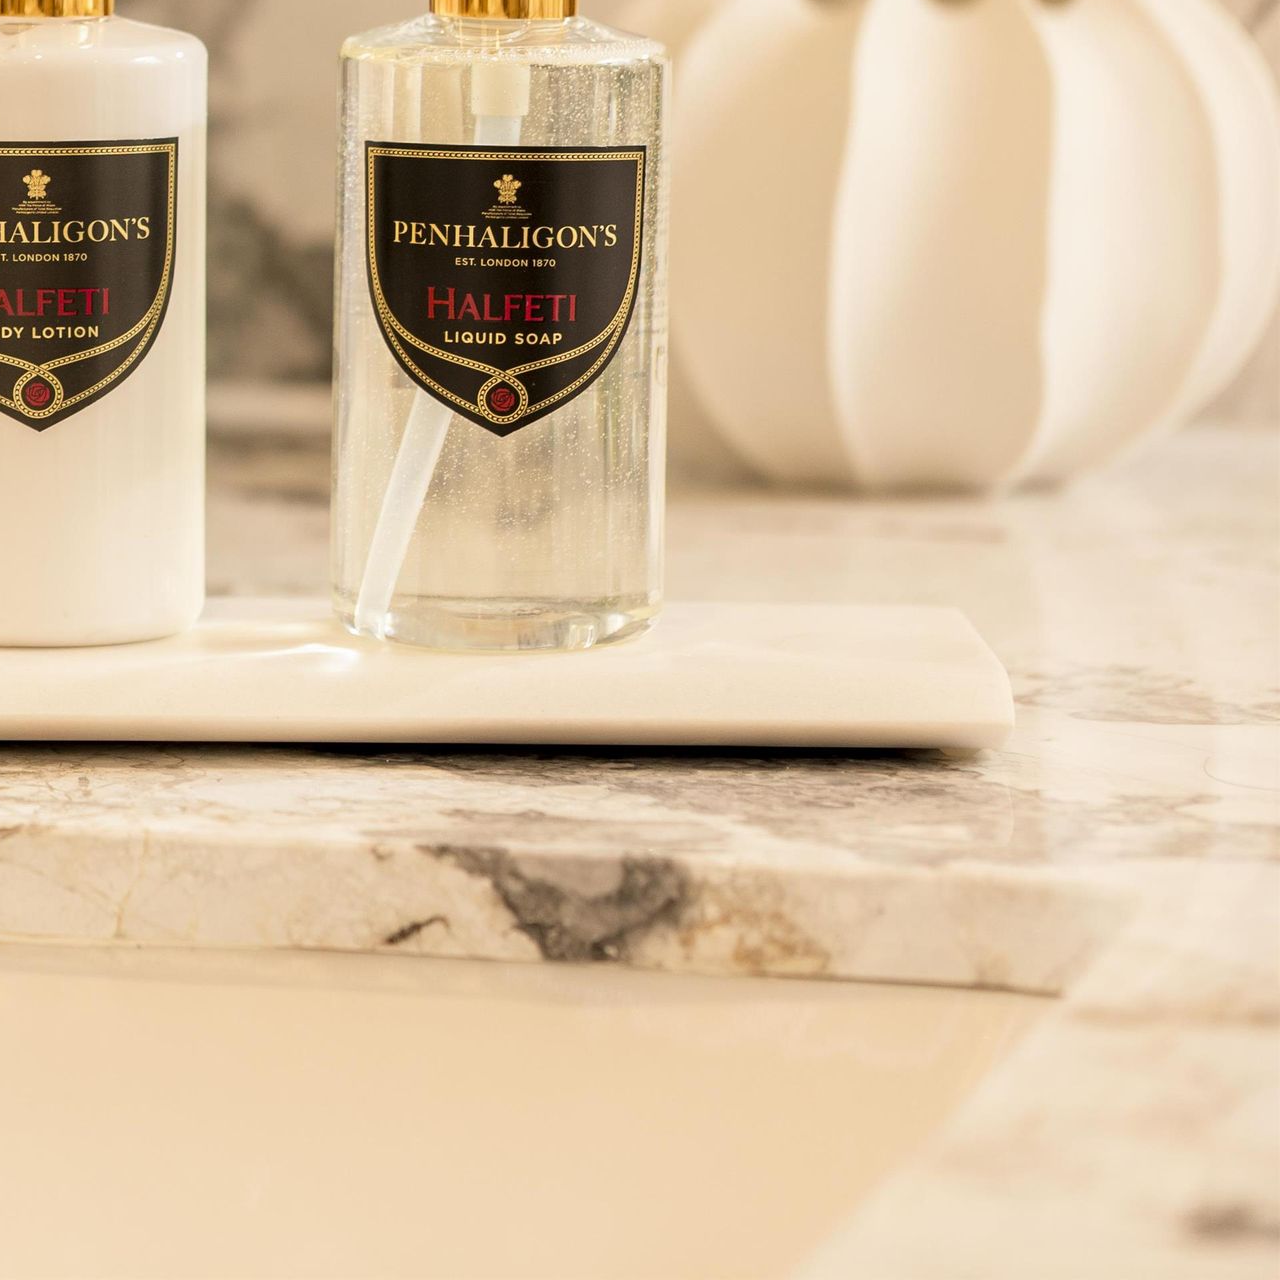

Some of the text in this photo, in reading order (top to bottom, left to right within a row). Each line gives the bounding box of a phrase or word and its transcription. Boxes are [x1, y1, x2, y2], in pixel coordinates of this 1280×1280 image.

[393, 221, 617, 249] PENHALIGON'S
[12, 253, 60, 262] LONDON
[64, 253, 88, 262] 1870
[455, 257, 556, 267] EST. LONDON 1870
[427, 286, 576, 322] HALFETI
[32, 326, 99, 338] LOTION
[444, 331, 562, 345] LIQUID SOAP
